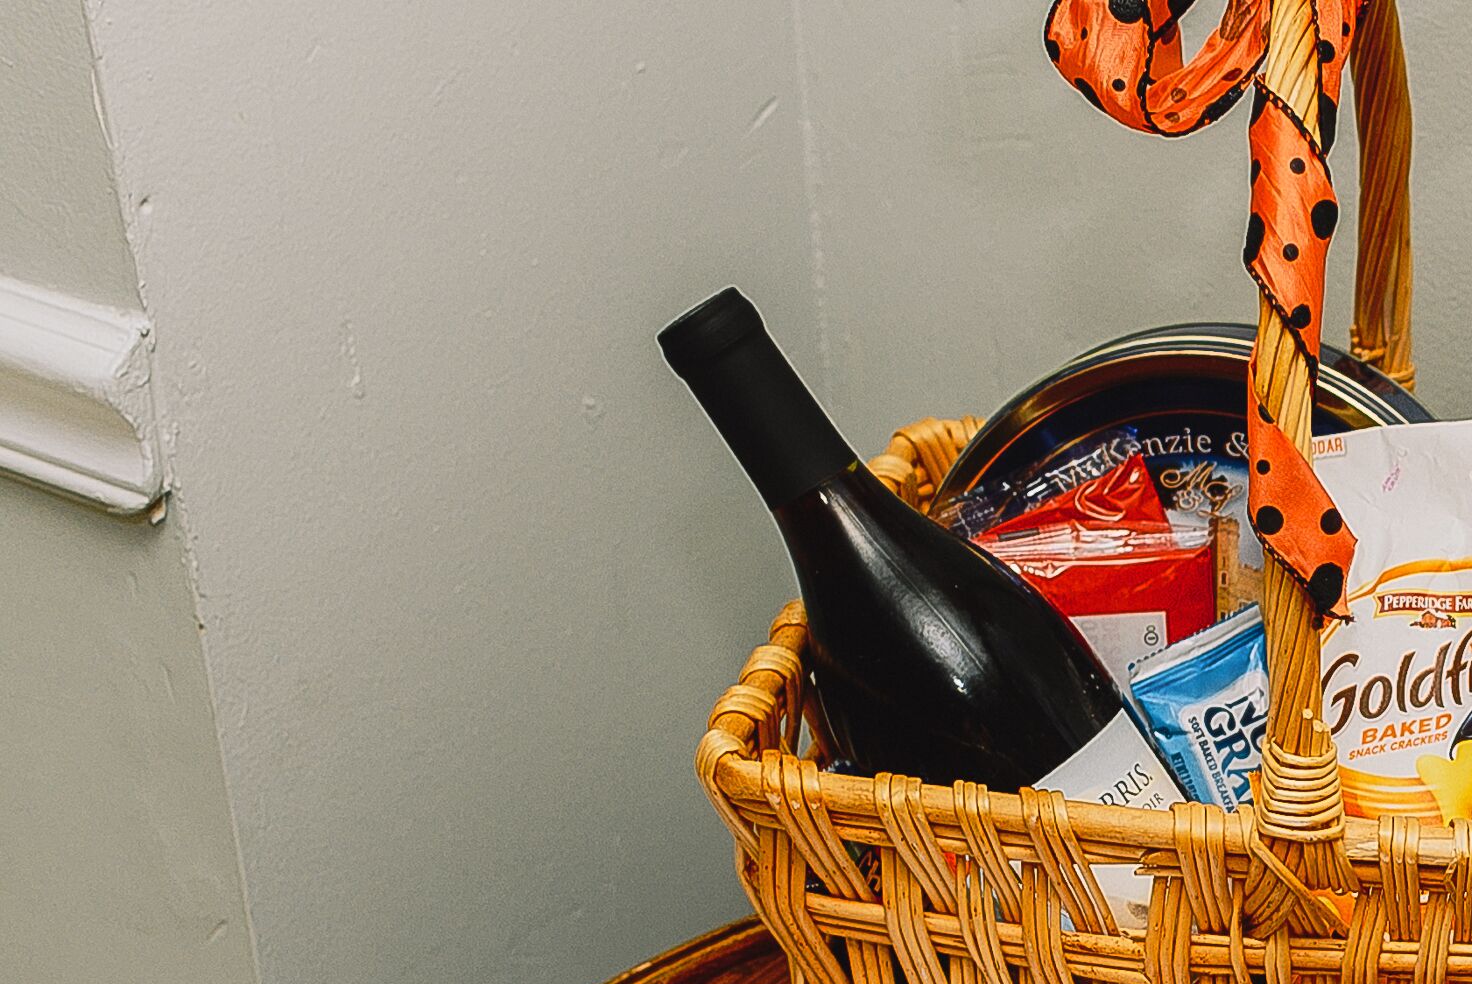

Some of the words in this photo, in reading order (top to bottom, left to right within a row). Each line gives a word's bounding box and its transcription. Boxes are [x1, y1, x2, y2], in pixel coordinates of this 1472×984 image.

[1383, 595, 1453, 611] PEPPERIDGE
[1187, 716, 1206, 741] SOFT
[1198, 739, 1219, 771] BAKED
[1361, 712, 1452, 746] BAKED
[1348, 744, 1387, 761] SNACK
[1390, 732, 1449, 751] CRACKERS
